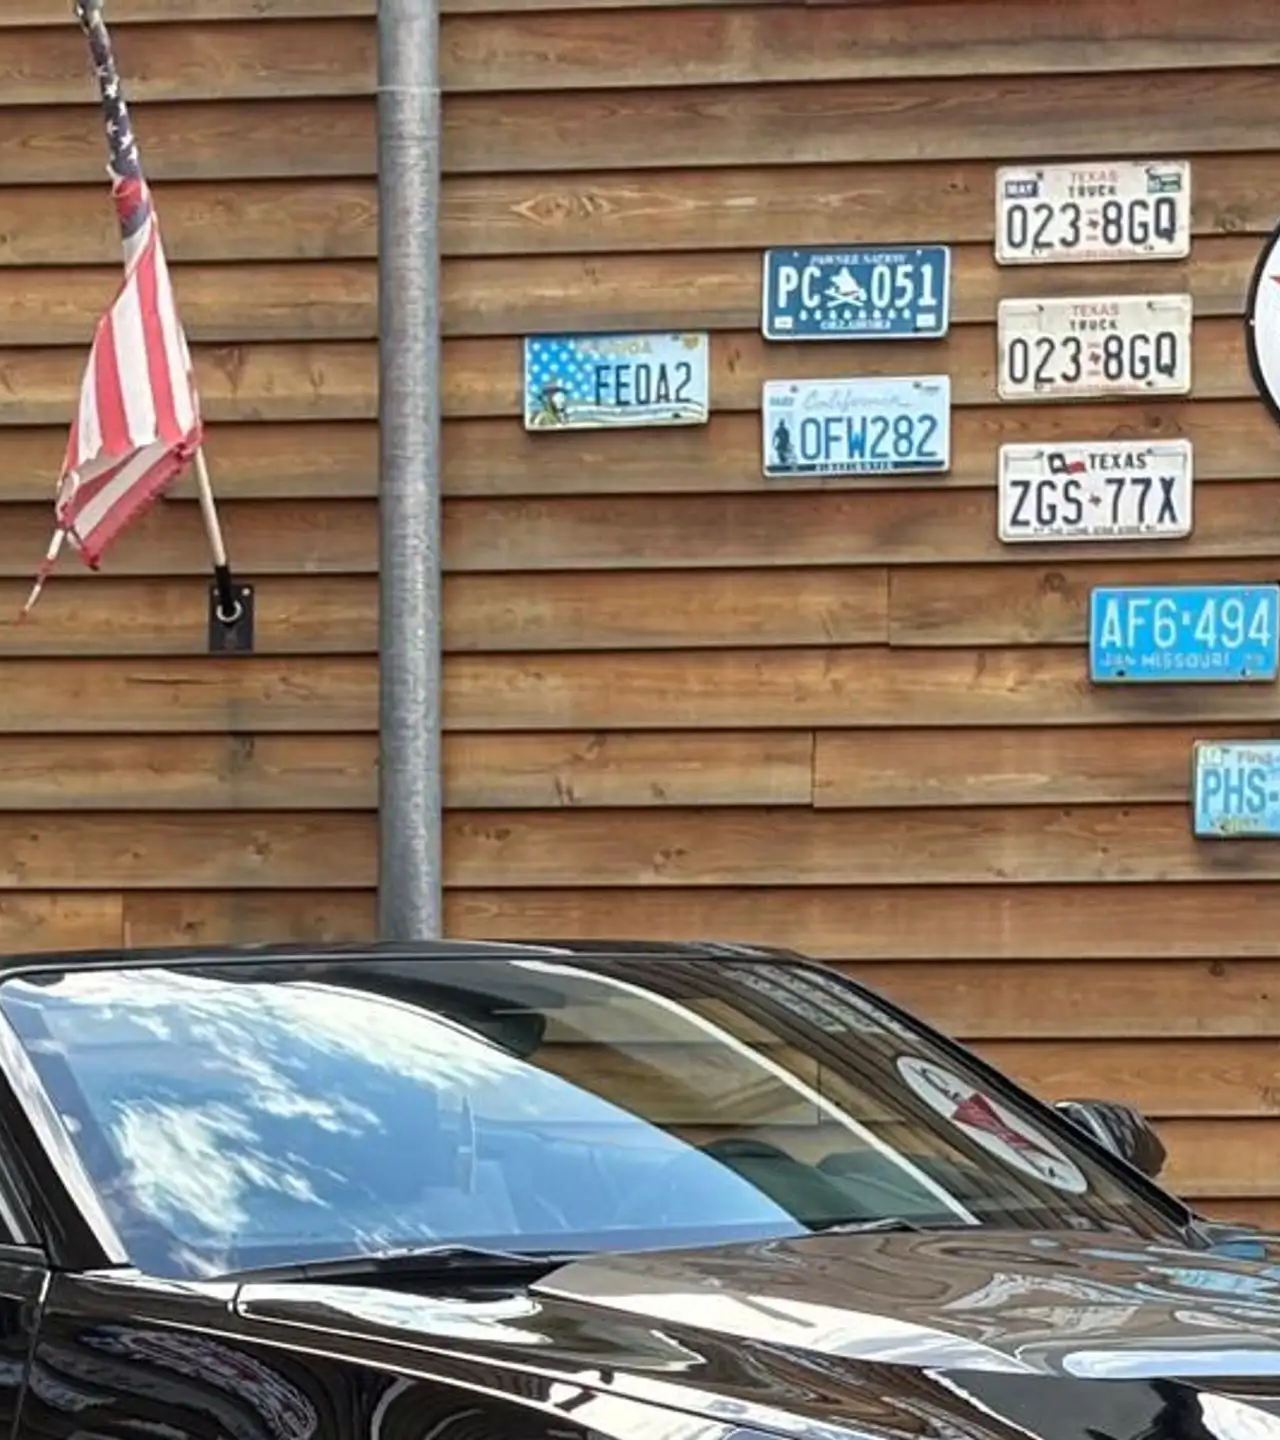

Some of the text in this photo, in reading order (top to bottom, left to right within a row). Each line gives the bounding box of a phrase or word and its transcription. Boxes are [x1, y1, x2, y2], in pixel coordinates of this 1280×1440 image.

[1072, 170, 1118, 183] TEXAS
[1072, 304, 1119, 316] TEXAS
[1089, 452, 1148, 471] TEXAS
[1009, 476, 1178, 527] ZGS 77X
[1141, 652, 1231, 669] MISSOURI
